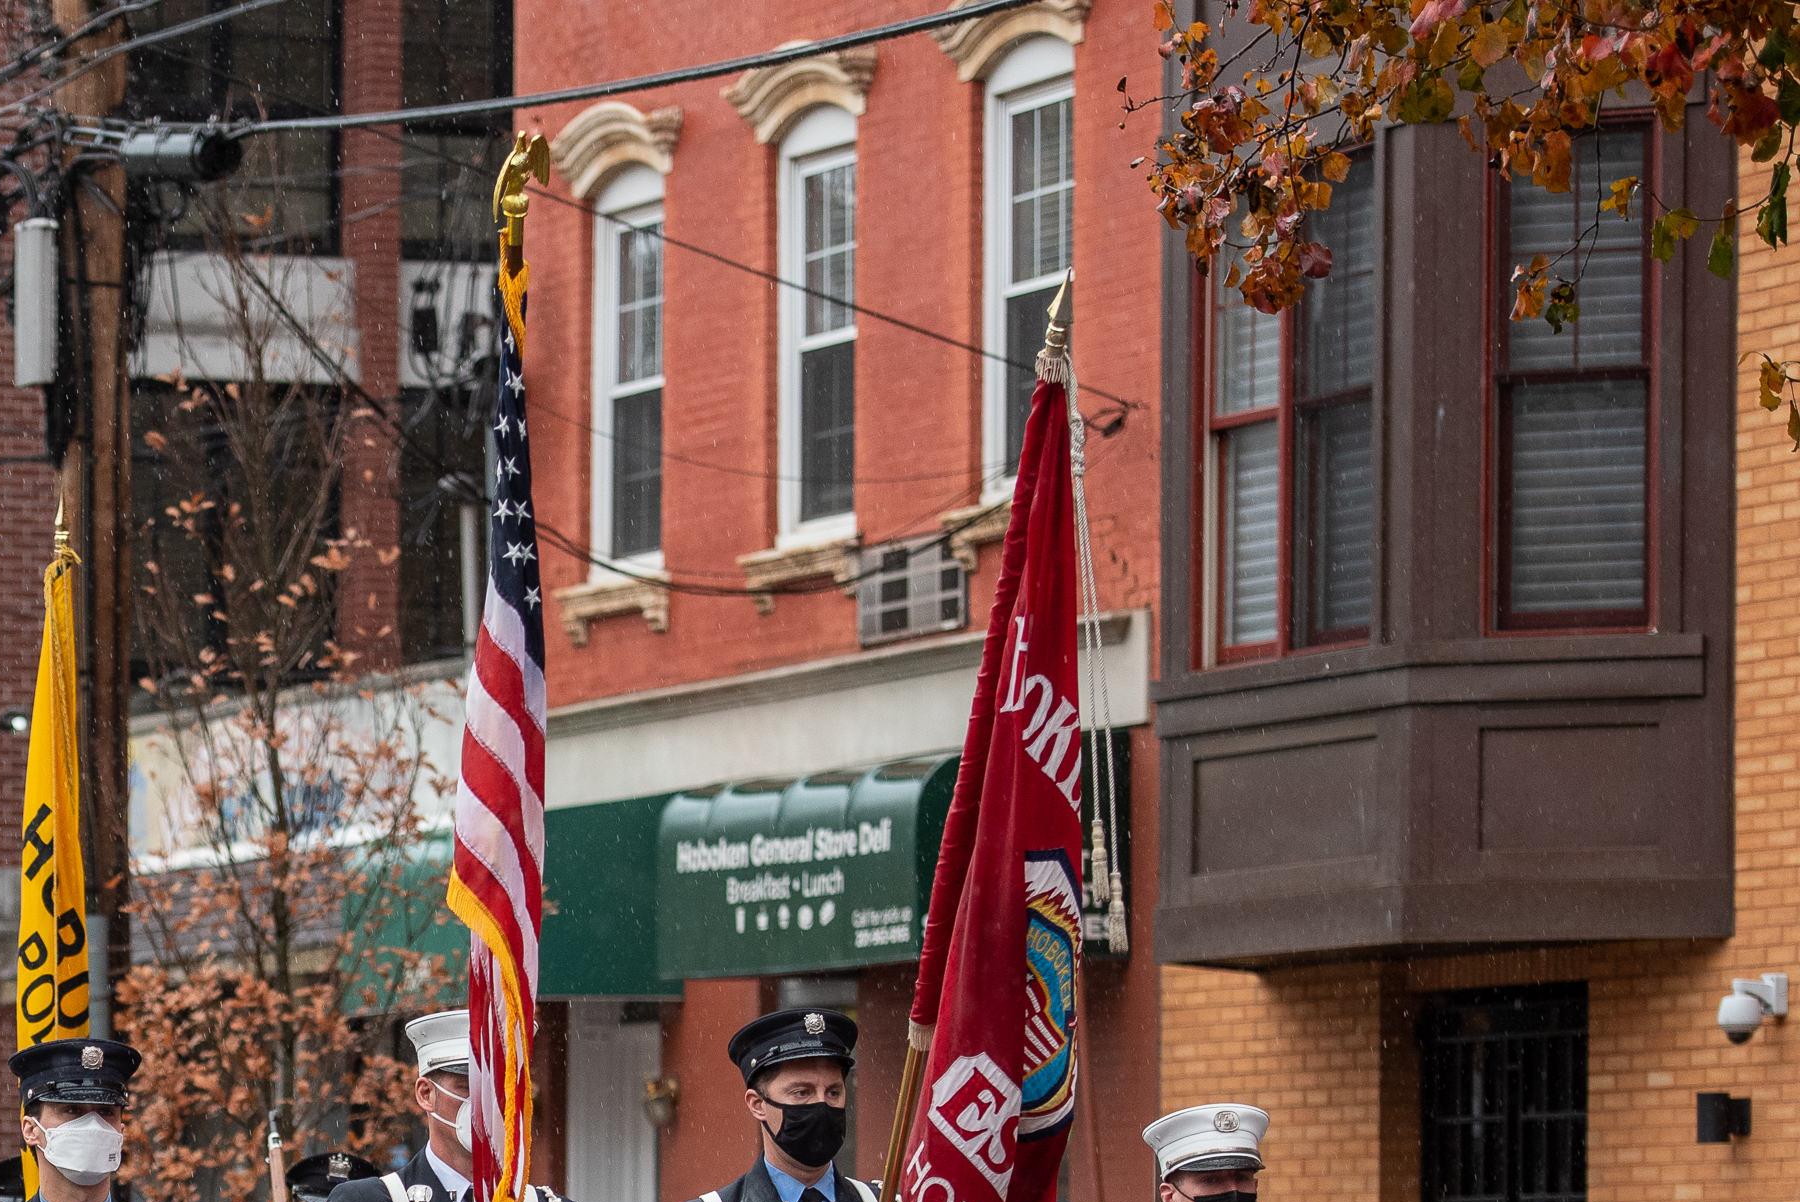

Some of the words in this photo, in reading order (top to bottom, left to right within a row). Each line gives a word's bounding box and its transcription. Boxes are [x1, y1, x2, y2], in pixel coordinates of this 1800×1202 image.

[676, 838, 749, 873] Hoboken
[750, 828, 813, 867] General
[814, 827, 858, 861] Store
[858, 816, 892, 855] Deli
[725, 872, 791, 904] Breakfast
[801, 865, 845, 898] Lunch
[1026, 926, 1072, 1012] HOBOKEN
